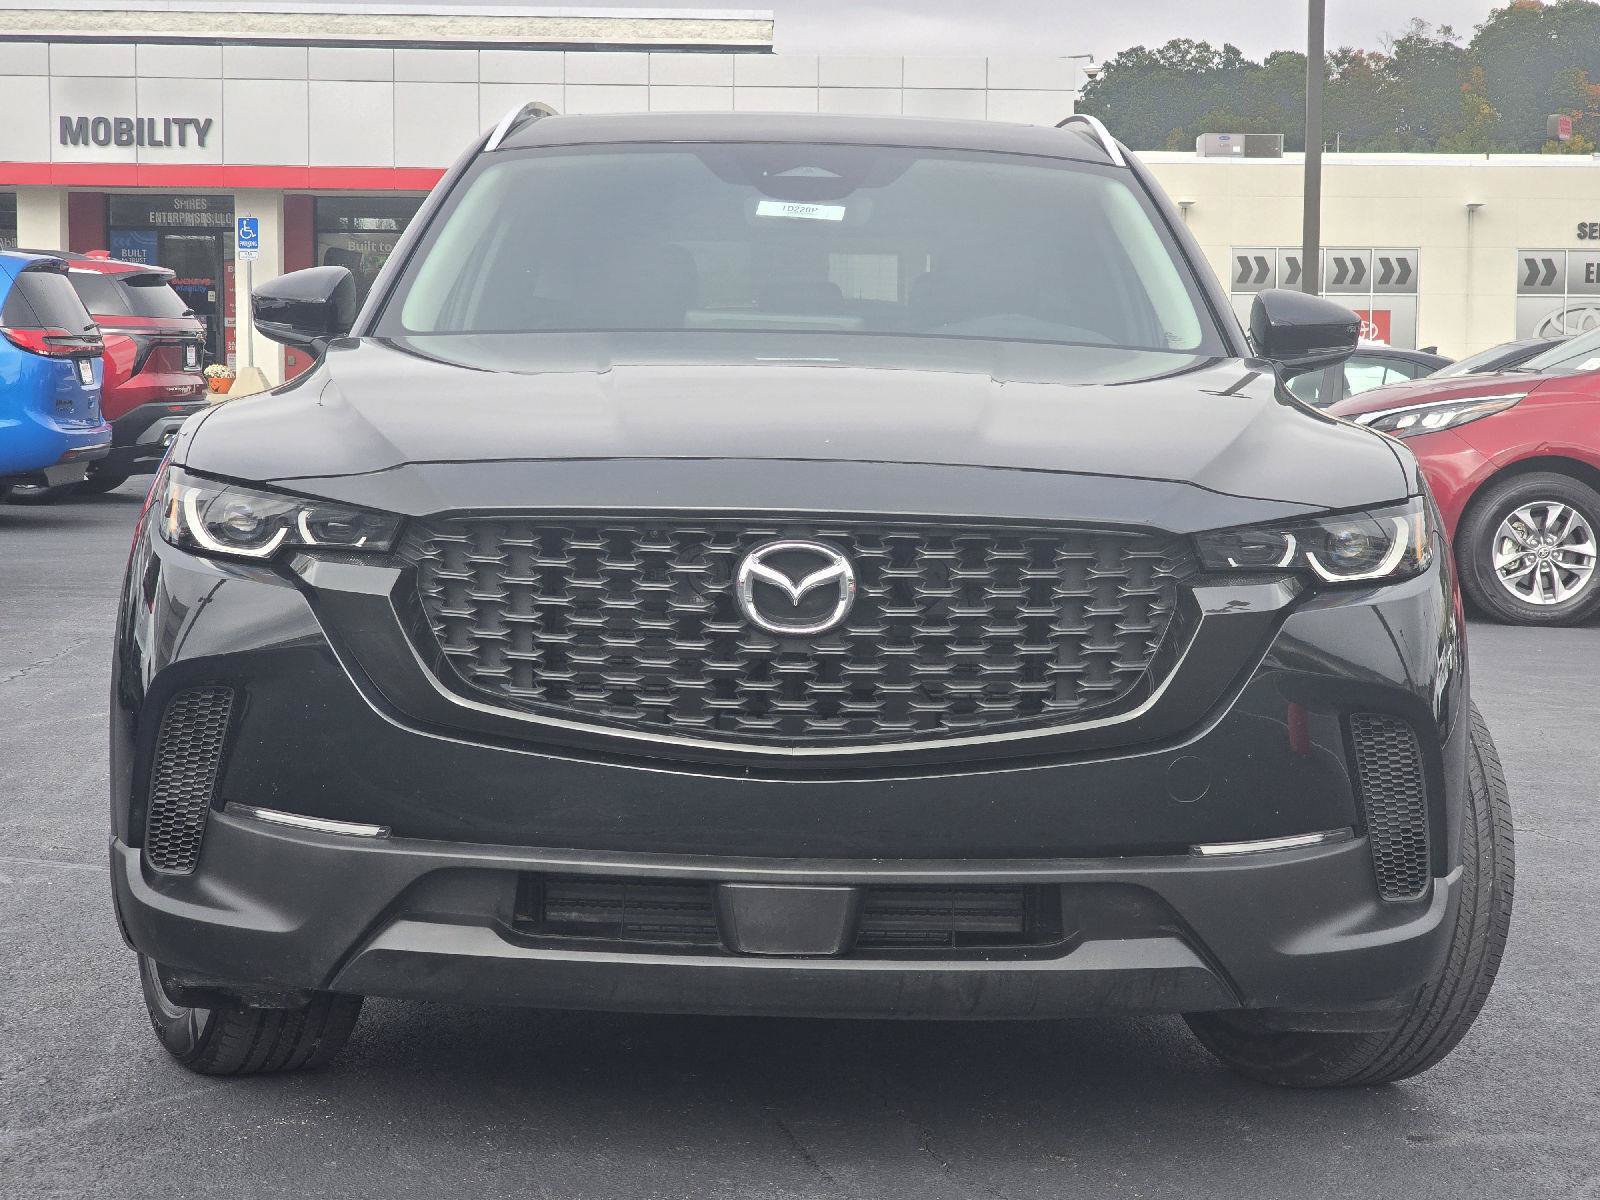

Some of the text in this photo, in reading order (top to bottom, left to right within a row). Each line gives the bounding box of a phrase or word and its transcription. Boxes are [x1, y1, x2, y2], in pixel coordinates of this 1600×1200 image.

[59, 115, 213, 147] MOBILITY
[1577, 222, 1600, 240] SE
[121, 248, 147, 257] BUILT
[348, 241, 392, 252] Built to
